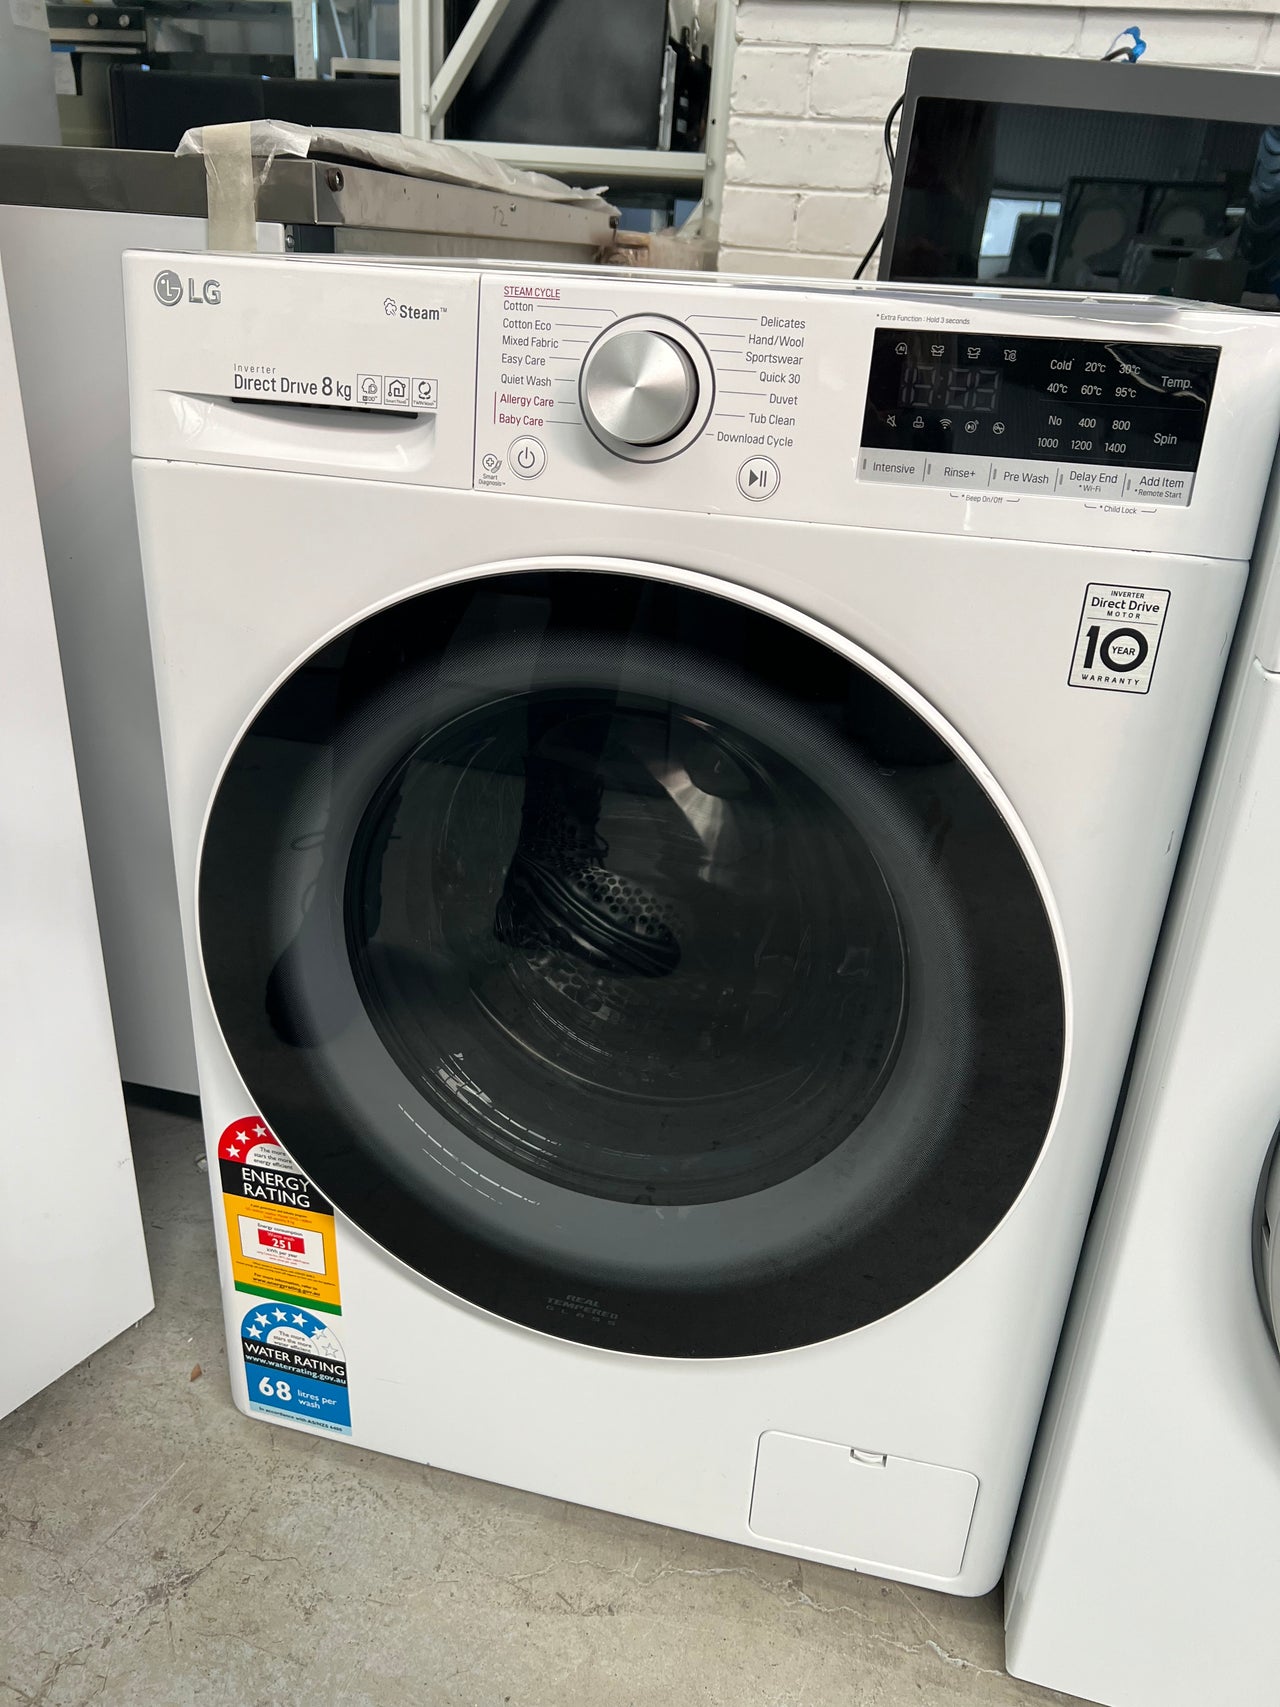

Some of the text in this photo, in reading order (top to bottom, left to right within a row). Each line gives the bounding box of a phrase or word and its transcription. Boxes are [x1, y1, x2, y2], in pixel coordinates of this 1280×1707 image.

[188, 277, 222, 306] LG
[503, 285, 561, 300] STEAM CYCLE
[503, 301, 534, 312] Cotton
[503, 318, 552, 331] Cotton Eco
[760, 316, 806, 329] Delicates
[502, 336, 559, 348] Mixed Fabric
[748, 334, 804, 348] Hand/Wool
[501, 354, 546, 366] Easy Care
[745, 352, 804, 366] Sportswear
[1050, 359, 1072, 371] Cold
[234, 363, 276, 374] Inverter
[500, 373, 552, 387] Quiet Wash
[759, 371, 801, 384] Quick 30
[1161, 376, 1193, 389] Temp.
[234, 374, 352, 401] Direct Drive 8 kg
[500, 394, 554, 407] Allergy Care
[769, 393, 798, 406] Duvet
[499, 413, 544, 427] Baby Care
[748, 413, 795, 426] Tub Clean
[1049, 416, 1131, 431] No 400 800
[717, 431, 793, 448] Download Cycle
[1038, 437, 1126, 454] 1000 1200 1400
[1153, 432, 1177, 446] Spin
[873, 461, 915, 474] Intensive
[944, 466, 976, 478] Rinse+
[1003, 471, 1049, 484] Pre Wash
[1070, 471, 1118, 484] Delay End
[1139, 476, 1184, 489] Add Item
[965, 494, 981, 503] Beep
[1138, 488, 1182, 499] Remote Start
[1104, 505, 1120, 513] Child
[1111, 590, 1144, 599] INVERTER
[1091, 596, 1160, 612] Direct Drive
[1107, 610, 1141, 619] MOTOR
[1083, 625, 1148, 672] 10
[1112, 646, 1136, 656] YEAR
[1081, 674, 1140, 686] WARRANTY
[241, 1167, 311, 1193] ENERGY
[243, 1182, 310, 1209] RATING
[272, 1238, 291, 1250] 251
[244, 1342, 345, 1376] WATER RATING
[245, 1354, 346, 1385] www.waterrating.gov.au
[258, 1376, 293, 1401] 68
[298, 1389, 337, 1405] litres per
[298, 1399, 320, 1409] wash
